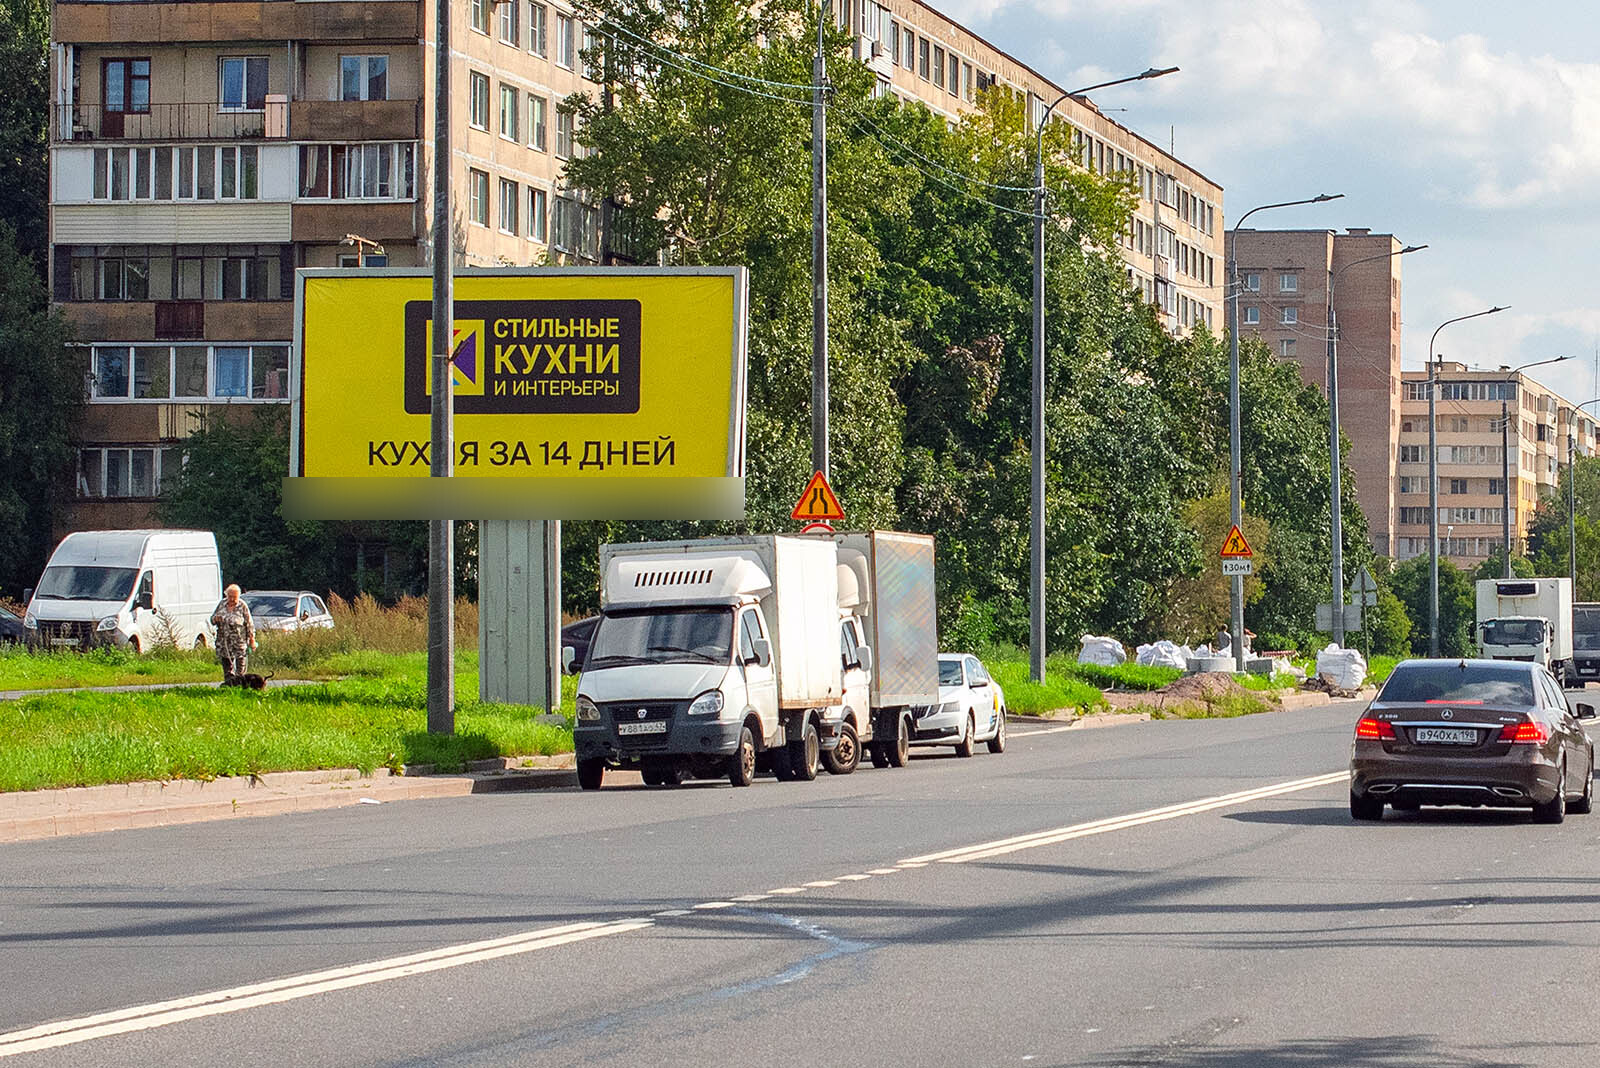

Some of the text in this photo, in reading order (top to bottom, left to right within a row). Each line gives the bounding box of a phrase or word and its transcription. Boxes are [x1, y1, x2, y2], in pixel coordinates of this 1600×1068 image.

[493, 318, 620, 339] СТИЛЬНЫЕ
[494, 344, 620, 374] КУХНИ
[494, 380, 620, 396] И ИНТЕРЬЕРЫ
[368, 435, 676, 470] КУХЯ ЗА 14 ДНЕЙ
